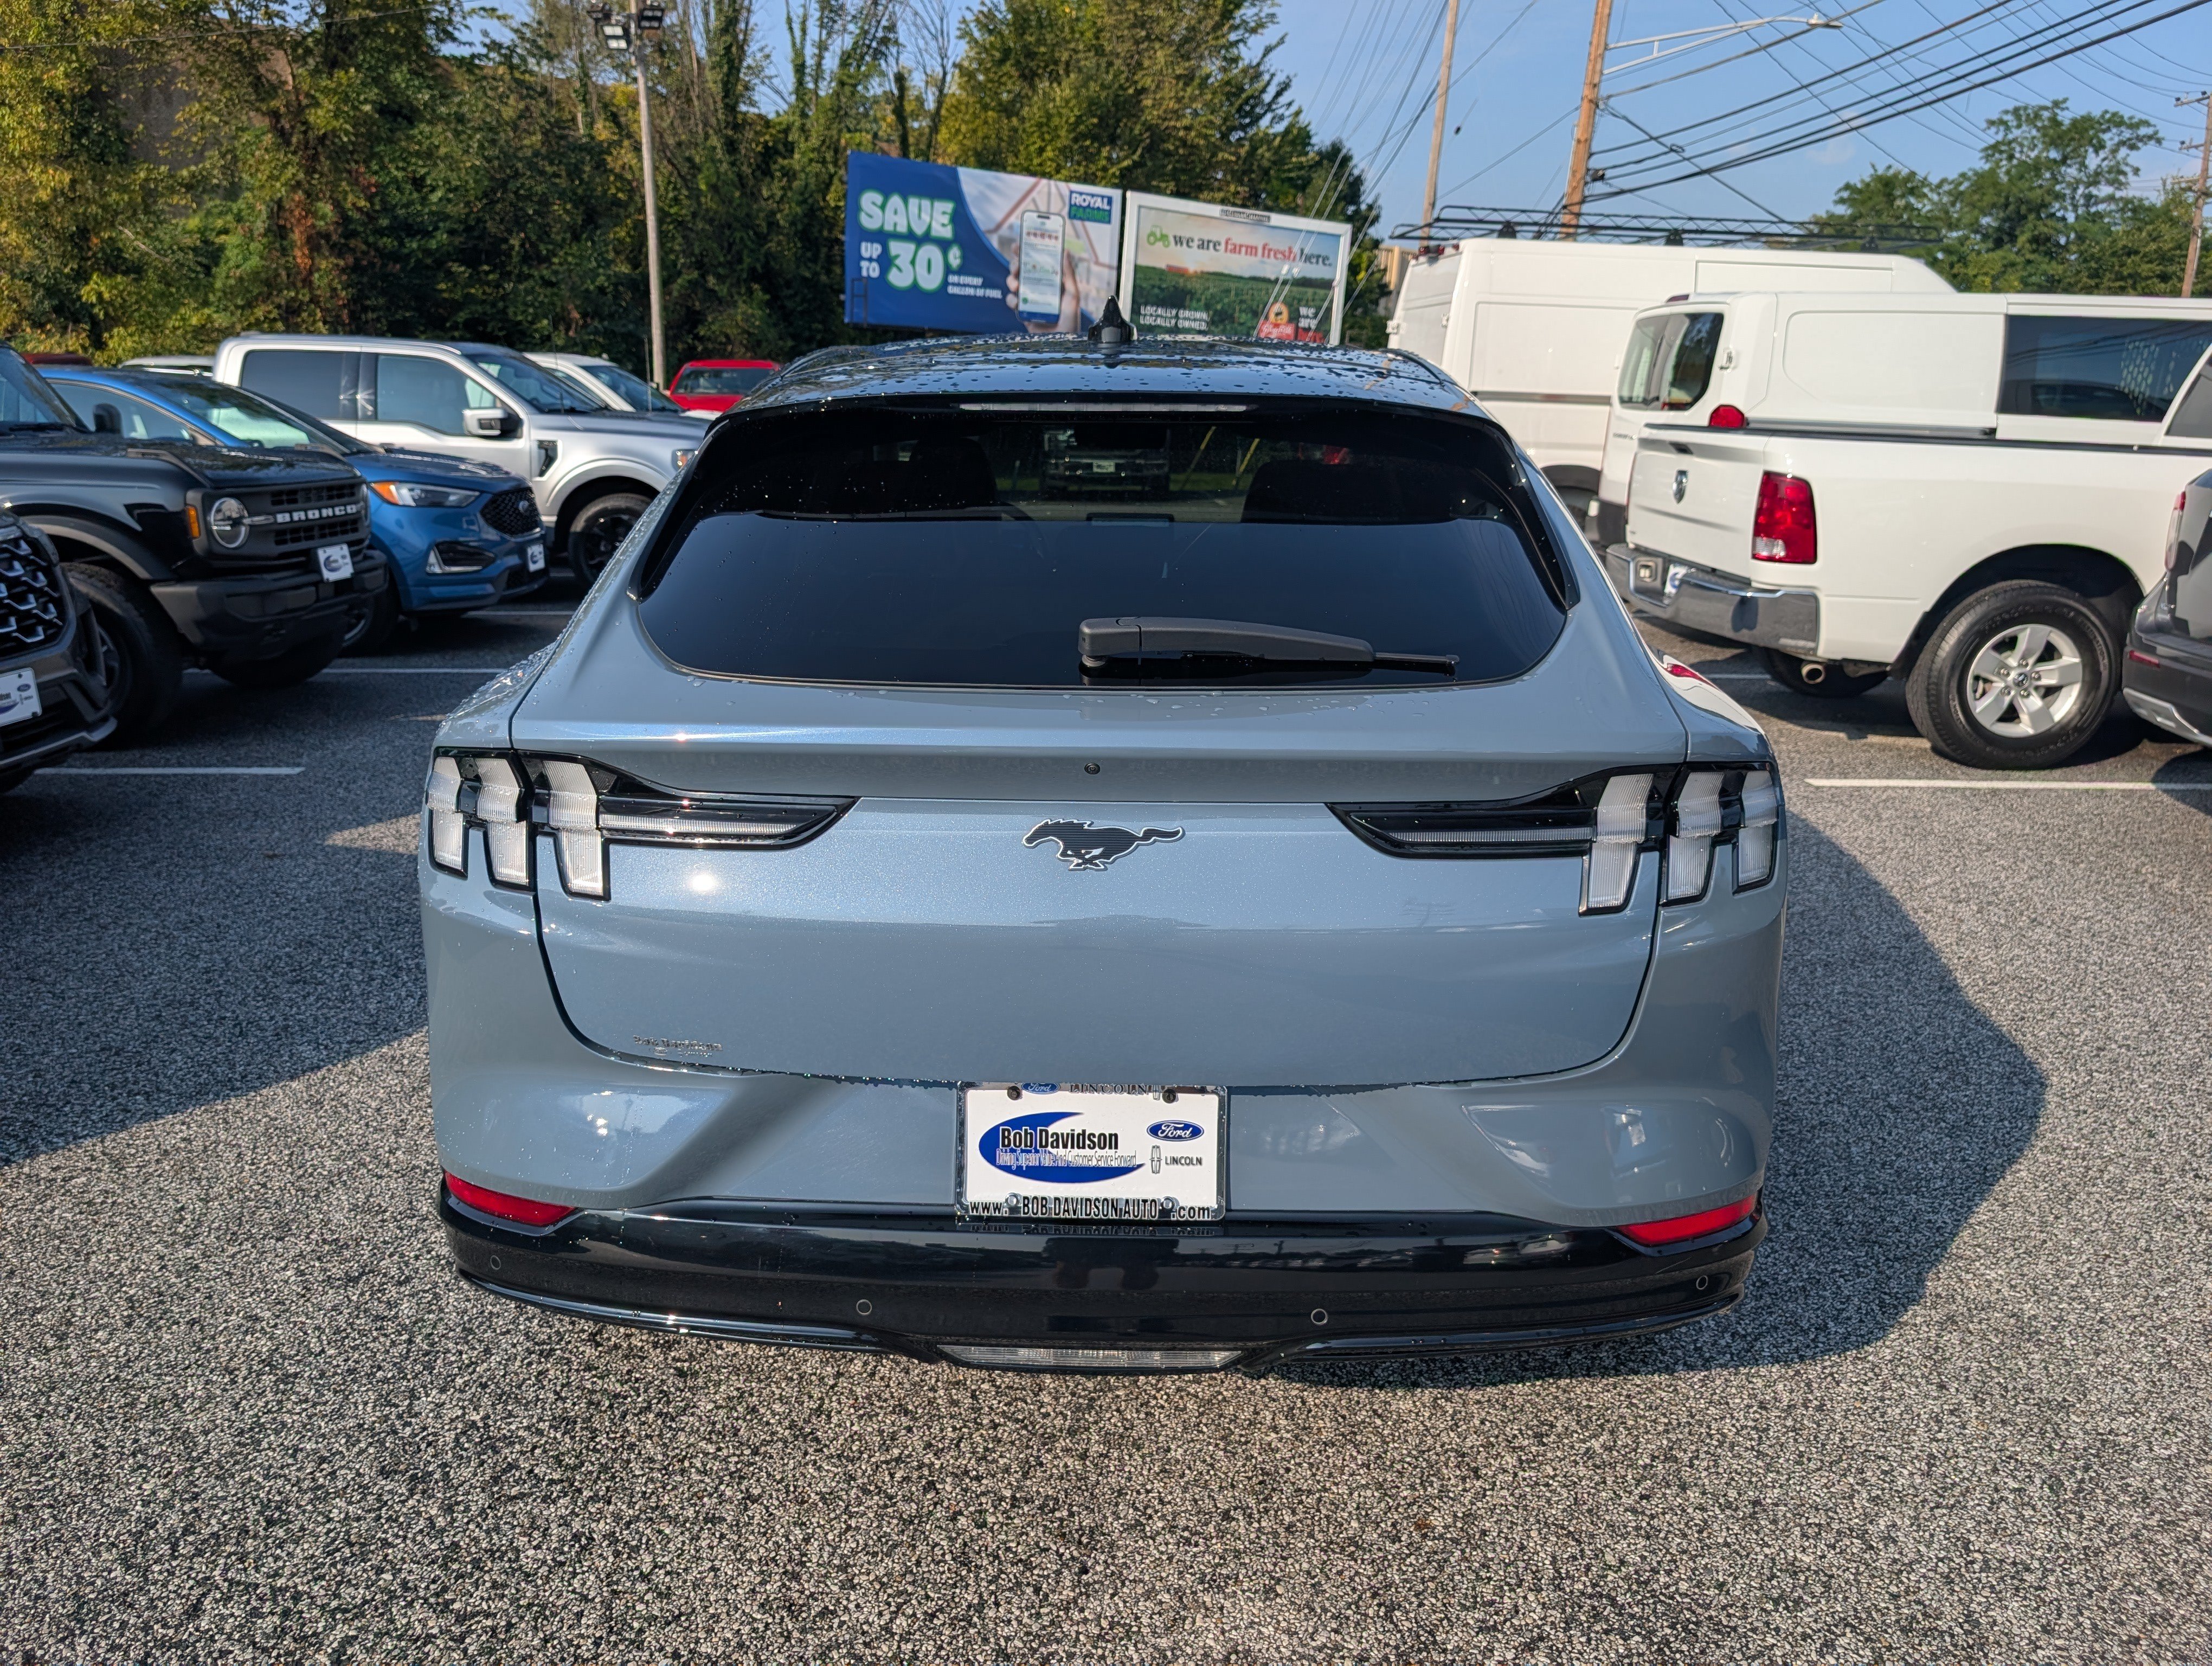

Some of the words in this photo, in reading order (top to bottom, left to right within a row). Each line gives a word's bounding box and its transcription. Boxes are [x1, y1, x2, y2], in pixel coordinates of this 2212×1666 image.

[1071, 193, 1110, 210] ROYAL
[859, 190, 955, 240] SAVE
[860, 241, 882, 259] UP
[1173, 234, 1194, 249] we
[1197, 238, 1221, 253] are
[1224, 237, 1258, 258] farm
[1261, 242, 1297, 262] fresh
[1299, 247, 1333, 267] here.
[859, 261, 880, 279] TO
[1140, 304, 1178, 318] LOCALLY
[1140, 315, 1176, 328] LOCALLY
[275, 504, 358, 523] BRONCO
[1069, 1084, 1148, 1094] LINCOLN
[1000, 1126, 1033, 1150] Bob
[1039, 1128, 1118, 1150] Davidson
[1158, 1123, 1192, 1138] Ford
[996, 1149, 1016, 1170] Driving
[1017, 1149, 1040, 1170] Superior
[1056, 1150, 1066, 1167] And
[1068, 1150, 1094, 1167] Customer
[1094, 1151, 1114, 1167] Service
[1114, 1150, 1136, 1167] Forward
[1165, 1156, 1203, 1166] LINCOLN
[969, 1200, 1008, 1216] www.
[1021, 1195, 1048, 1216] BOB
[1052, 1196, 1118, 1219] DAVIDSON
[1122, 1197, 1158, 1219] AUTO
[1171, 1204, 1211, 1220] .com
